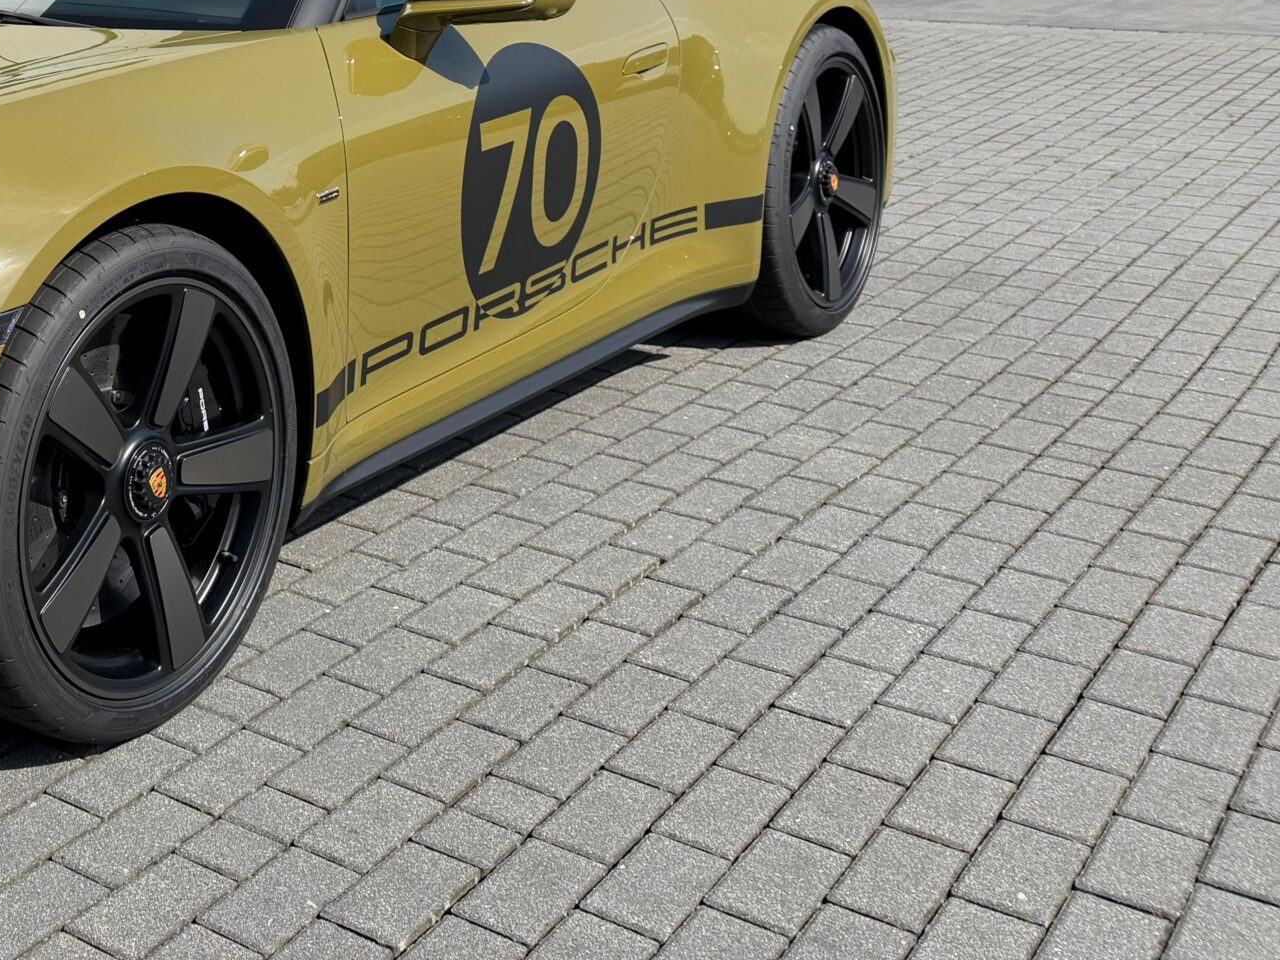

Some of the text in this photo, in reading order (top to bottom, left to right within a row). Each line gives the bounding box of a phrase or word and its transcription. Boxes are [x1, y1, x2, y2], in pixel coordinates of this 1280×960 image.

[477, 94, 589, 276] 70
[360, 204, 698, 388] PORSCHE
[198, 387, 209, 432] PORS
